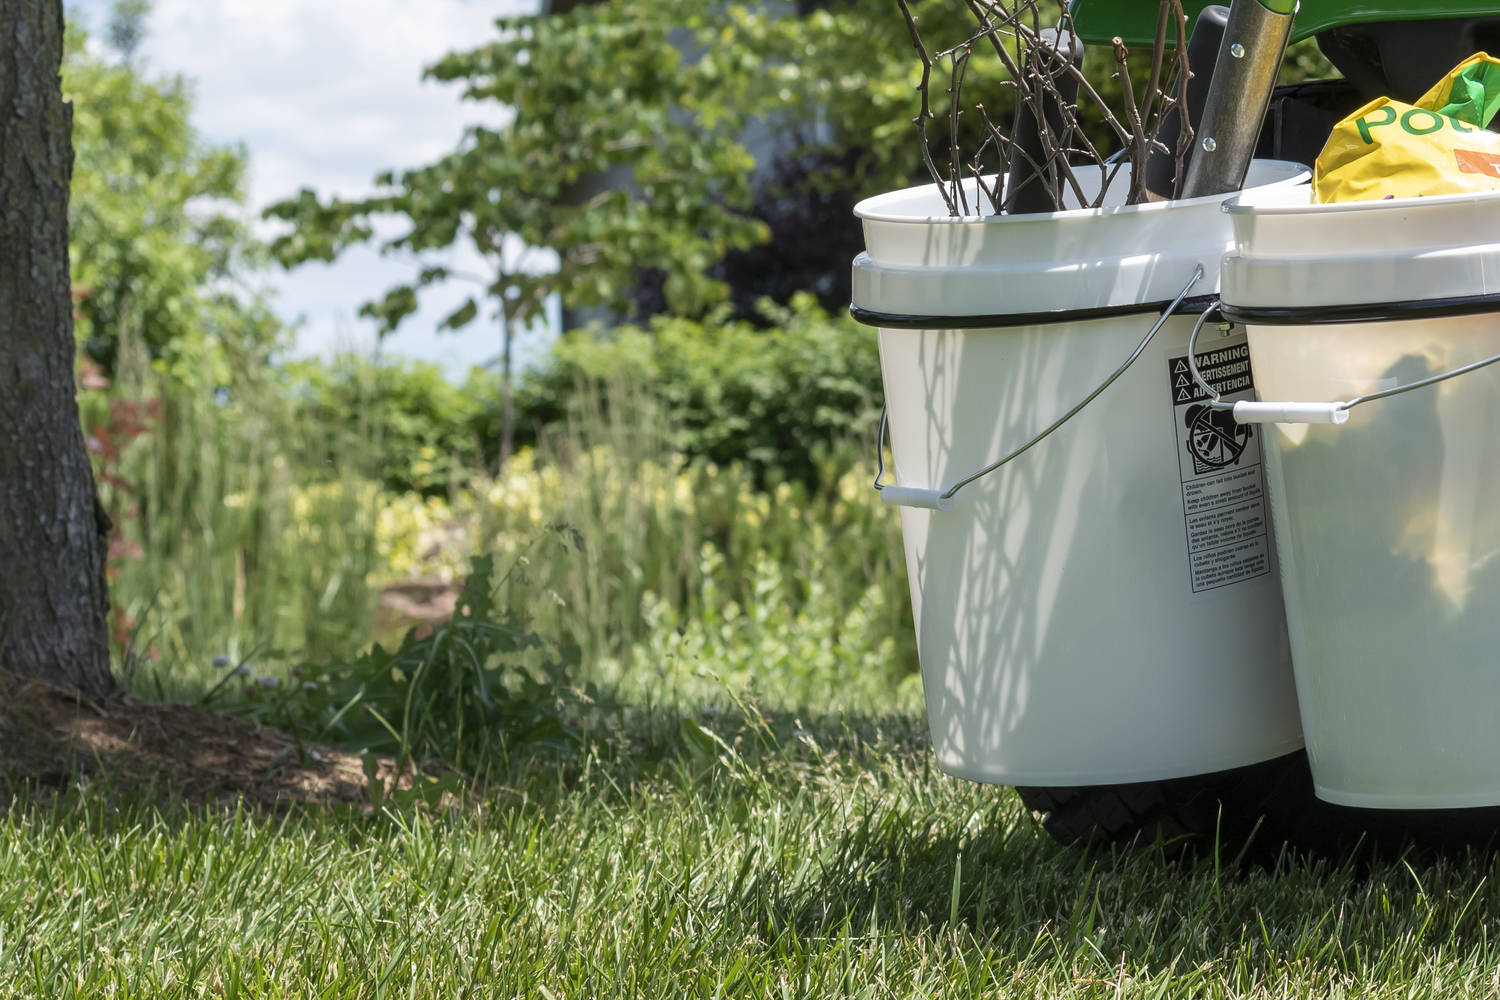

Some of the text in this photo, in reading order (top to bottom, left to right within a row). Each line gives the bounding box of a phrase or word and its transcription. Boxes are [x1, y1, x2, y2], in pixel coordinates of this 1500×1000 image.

[1194, 346, 1249, 368] WARNING
[1192, 360, 1249, 384] ERTISSEMENT
[1193, 375, 1250, 399] ADERTENCIA
